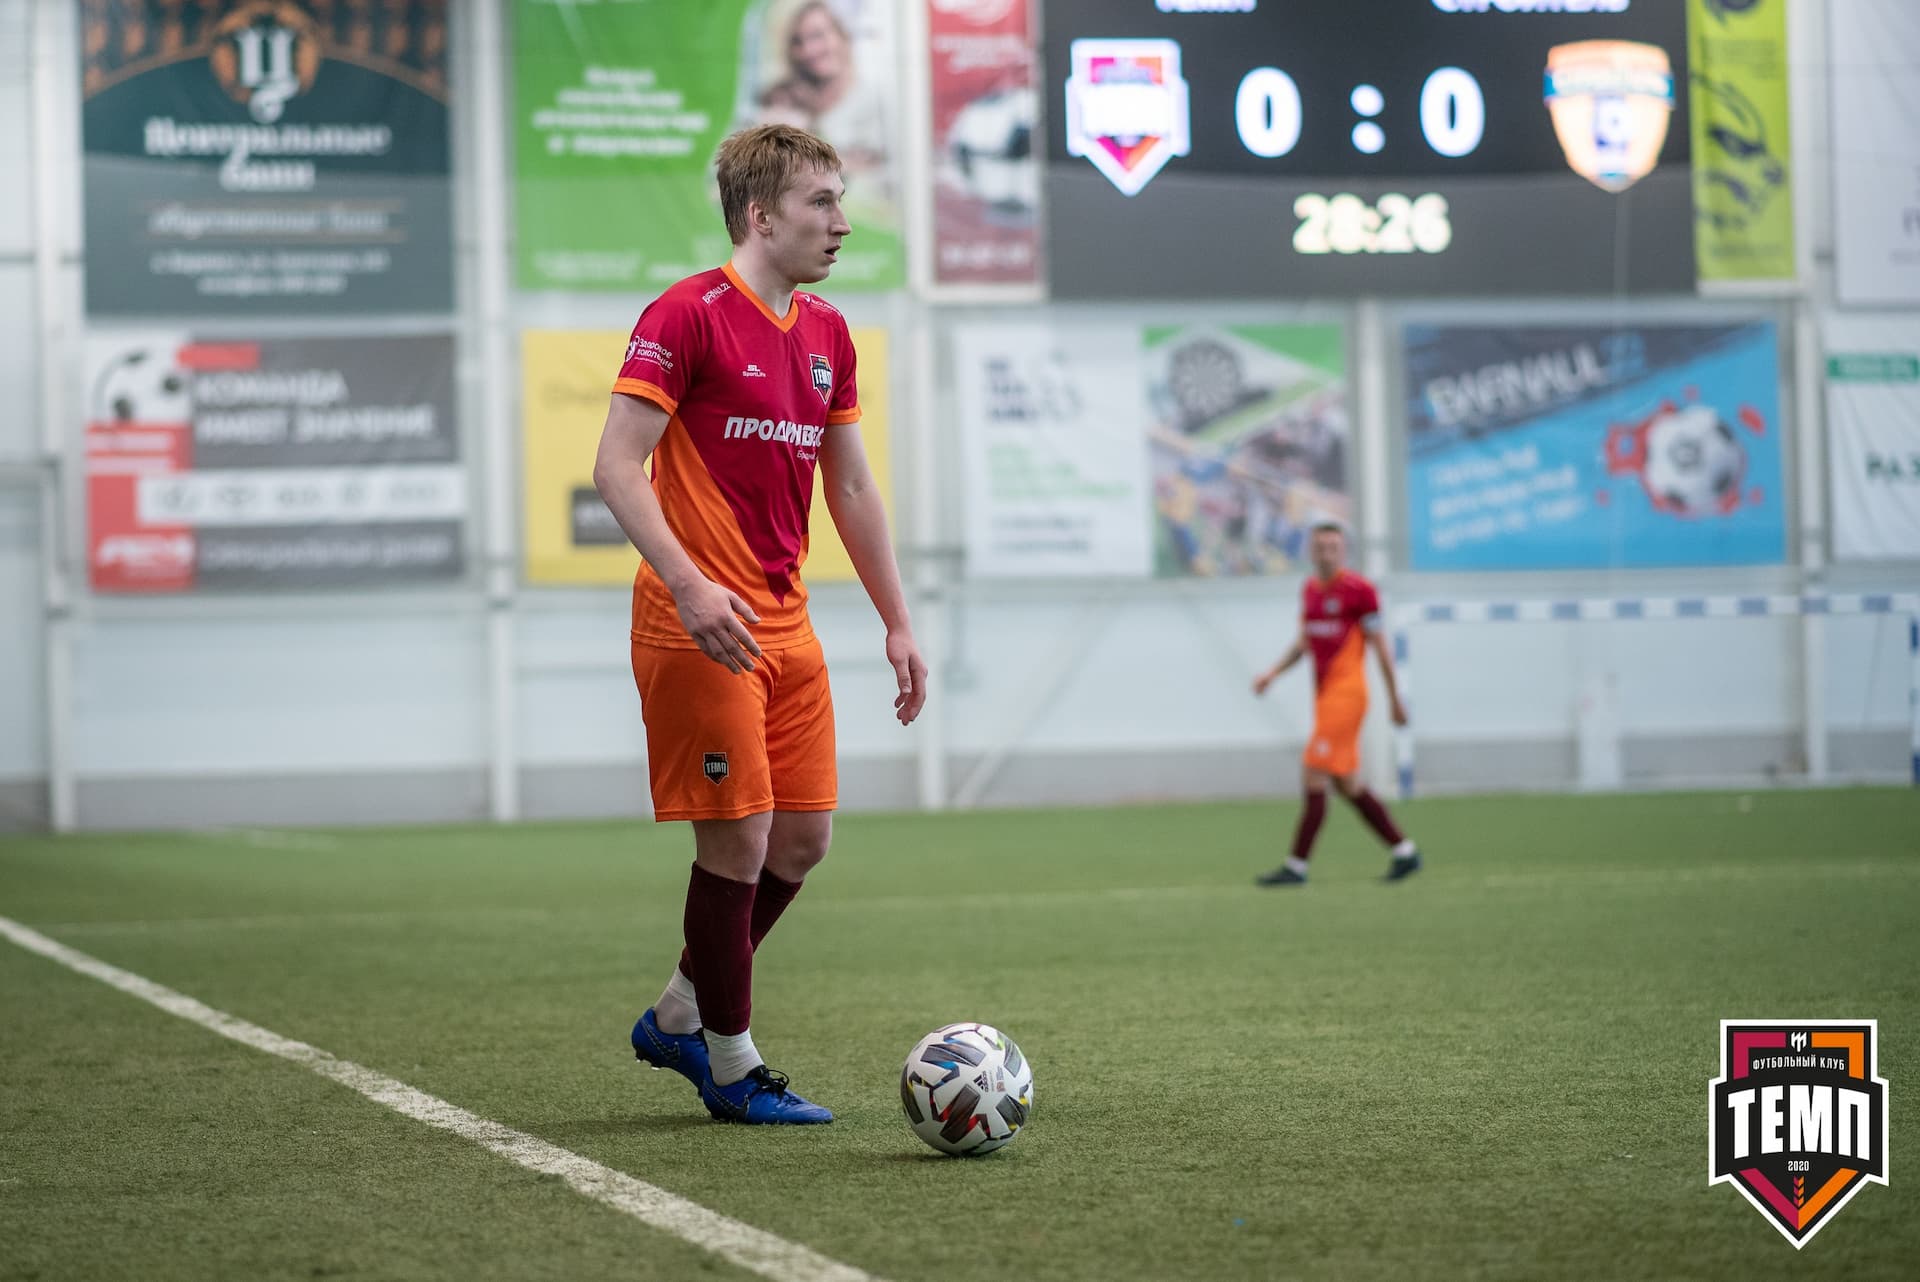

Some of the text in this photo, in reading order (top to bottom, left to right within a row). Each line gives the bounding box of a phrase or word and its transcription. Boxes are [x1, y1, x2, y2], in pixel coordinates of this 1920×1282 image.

[1235, 67, 1301, 157] 0
[1420, 67, 1485, 157] 0
[1293, 193, 1451, 253] 28:26
